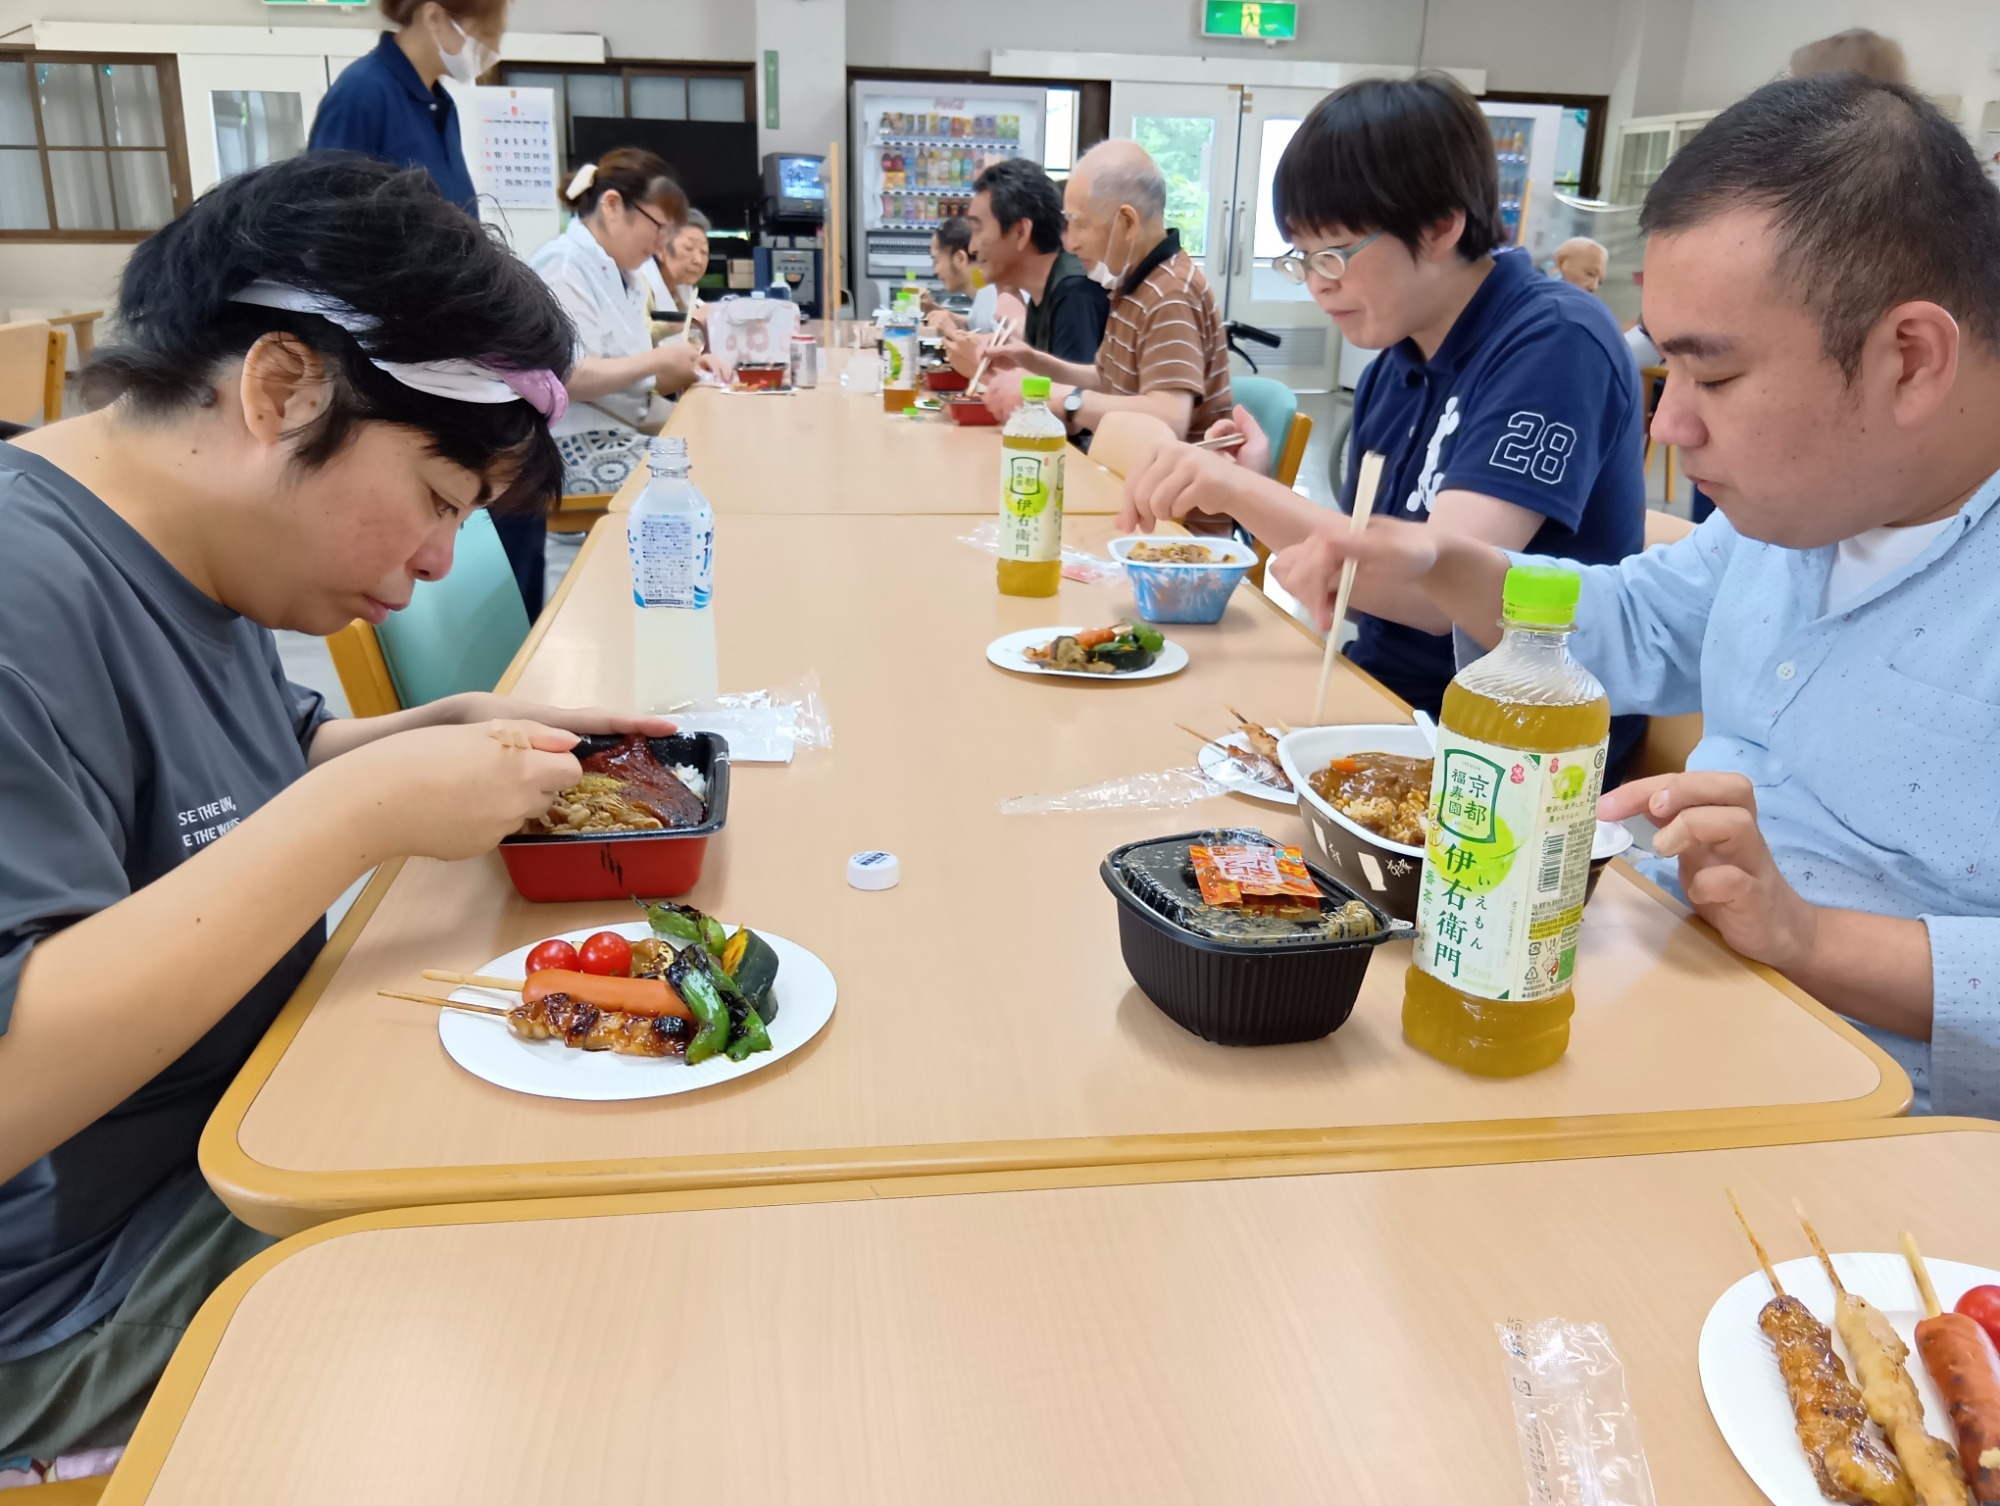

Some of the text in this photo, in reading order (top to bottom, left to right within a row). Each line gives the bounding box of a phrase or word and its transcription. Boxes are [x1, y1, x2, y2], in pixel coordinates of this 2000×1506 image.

[1489, 411, 1577, 485] 28
[197, 801, 221, 822] THE
[1448, 768, 1468, 817] 福寿園
[1463, 774, 1490, 827] 京都
[193, 826, 218, 845] THE
[1434, 842, 1477, 978] 伊右衛門
[1470, 874, 1491, 950] いえもん
